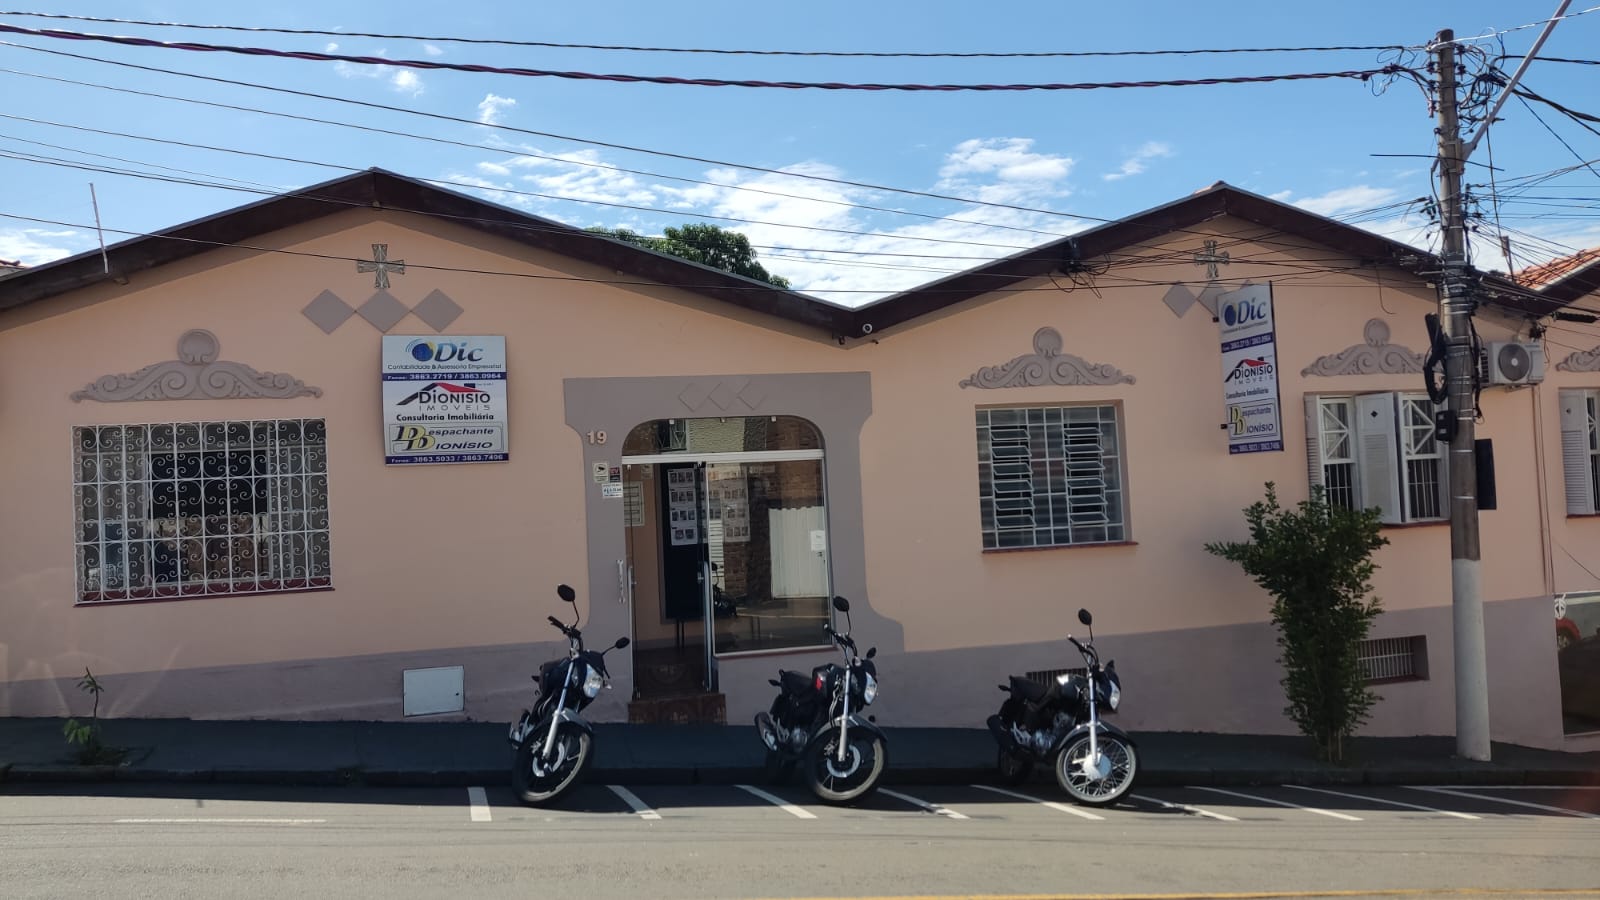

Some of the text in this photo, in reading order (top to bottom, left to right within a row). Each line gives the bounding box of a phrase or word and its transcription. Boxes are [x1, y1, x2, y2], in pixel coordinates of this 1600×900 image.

[1237, 297, 1267, 325] Dic
[434, 342, 484, 362] Dic
[396, 412, 494, 421] Consultoria Imobiliária
[587, 430, 607, 444] 19
